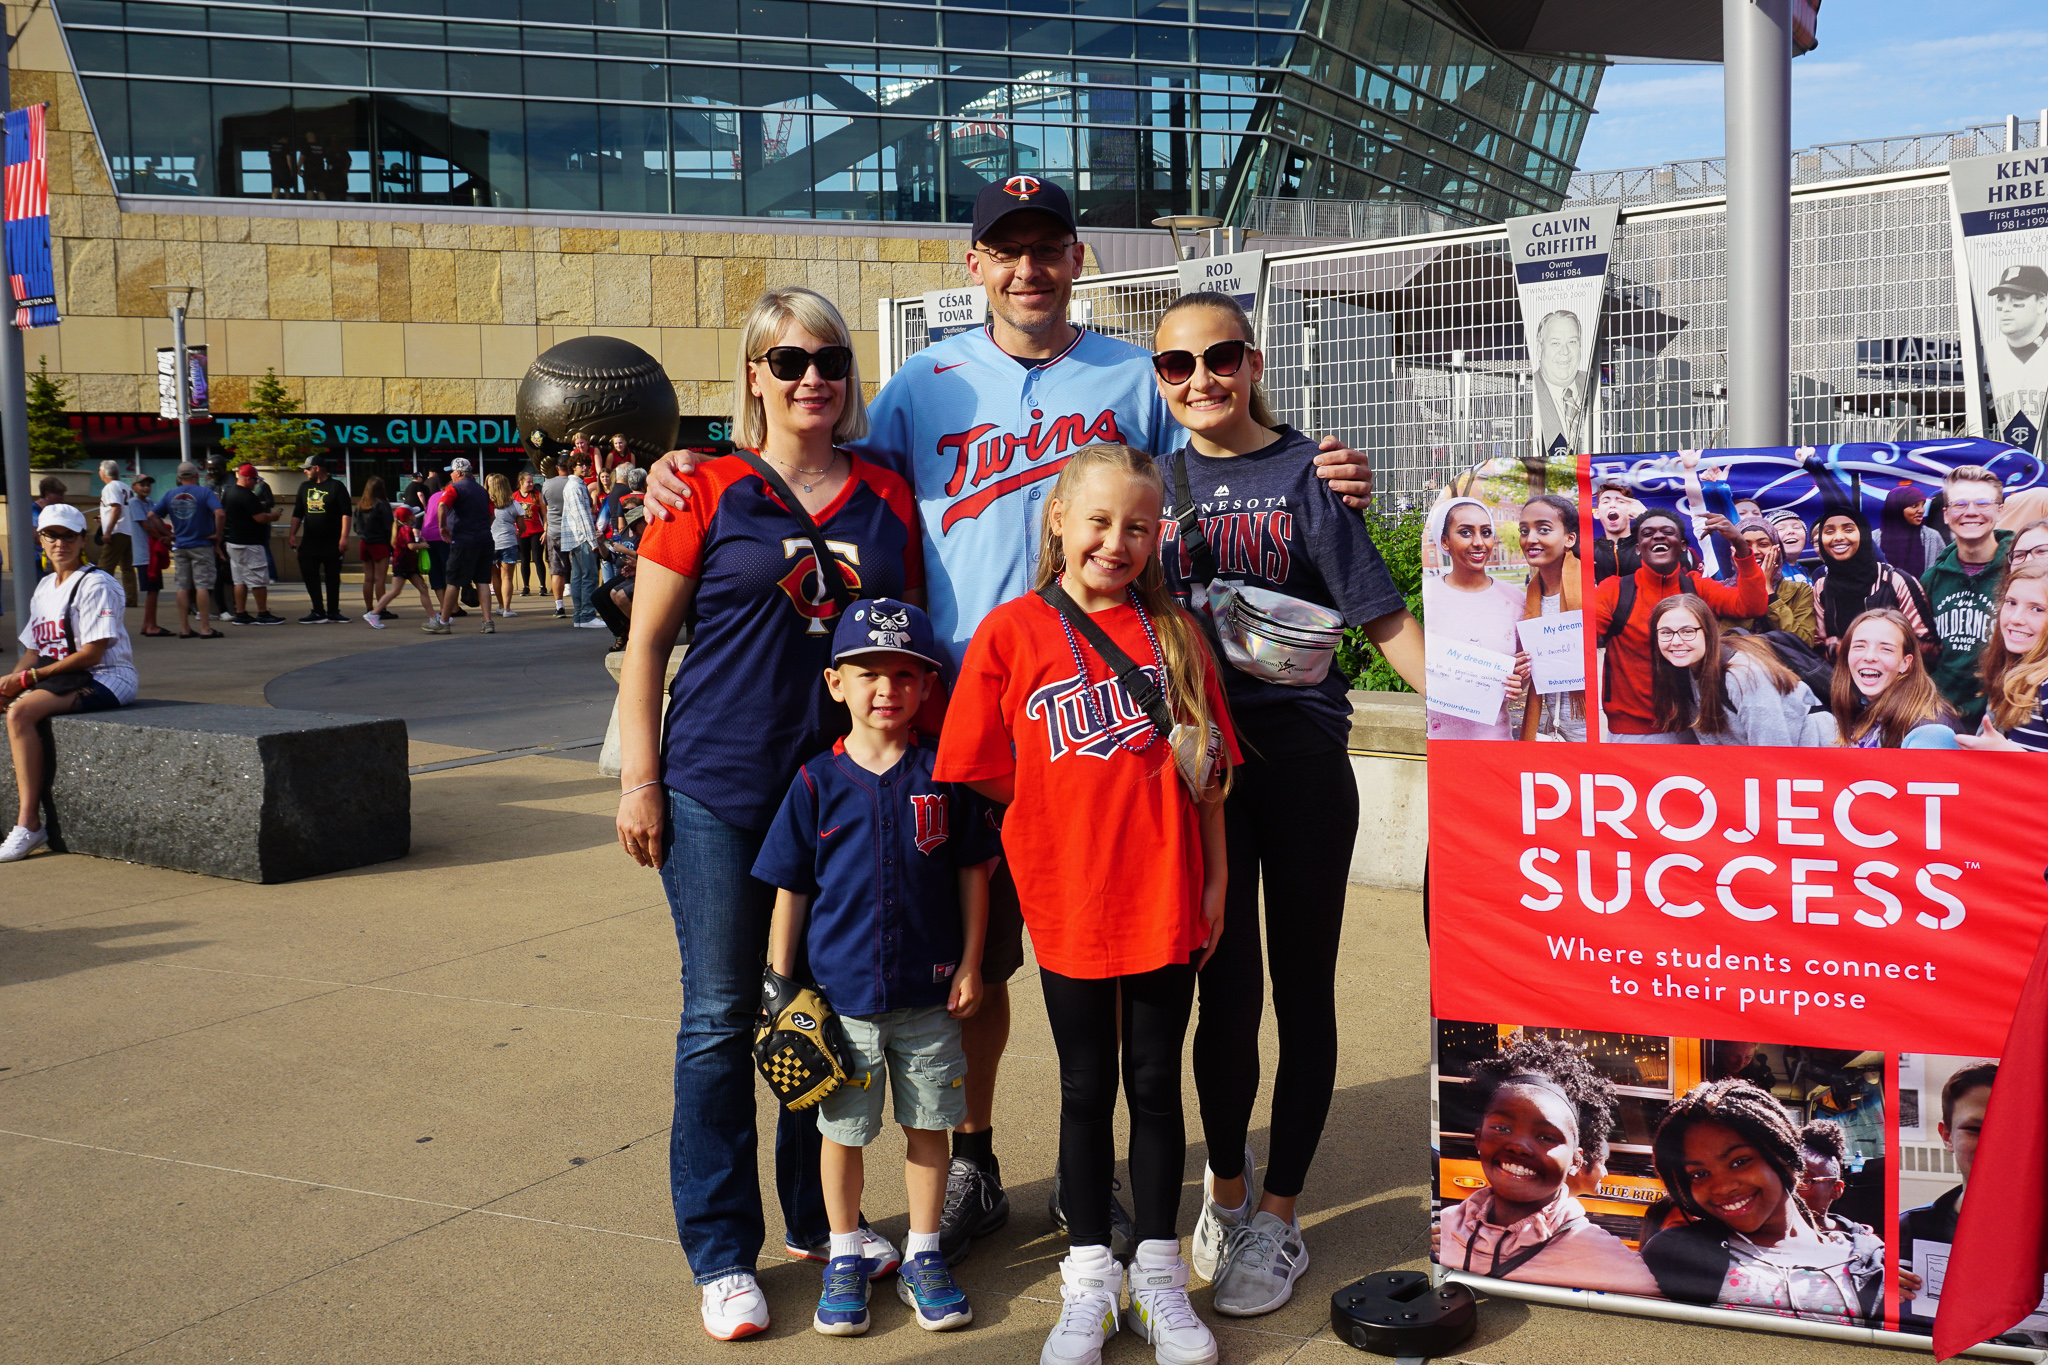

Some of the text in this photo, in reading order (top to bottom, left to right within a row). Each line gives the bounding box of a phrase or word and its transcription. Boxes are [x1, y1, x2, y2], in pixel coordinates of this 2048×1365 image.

[1989, 211, 2010, 221] First
[1532, 216, 1590, 237] CALVIN
[1525, 234, 1597, 257] GRIFFITH
[1975, 235, 2042, 250] TWINS HALL OF
[1988, 246, 2033, 258] INDUCTED
[1206, 262, 1233, 278] ROD
[1548, 260, 1573, 270] Owner
[1541, 267, 1581, 280] 1961-1984
[1199, 277, 1241, 293] CAREW
[1526, 281, 1594, 295] TWINS HALL OF FAME
[938, 293, 972, 308] CÉSAR
[1535, 293, 1568, 302] INDUCTED
[938, 309, 973, 323] TOVAR
[334, 425, 378, 444] vs.
[937, 409, 1127, 497] Twins
[1162, 495, 1288, 517] MNESOTA
[1543, 622, 1583, 635] My dream
[1949, 636, 1976, 645] CANOE
[1447, 648, 1462, 661] My
[1464, 652, 1491, 668] dream
[1520, 772, 1960, 850] PROJECT
[1519, 847, 1967, 931] SUCCESS
[1546, 935, 1938, 982] Where students connect
[1610, 973, 1866, 1015] to their purpose
[1633, 1190, 1664, 1202] BIRD
[1080, 1279, 1102, 1287] adidas
[1149, 1276, 1171, 1284] adidas
